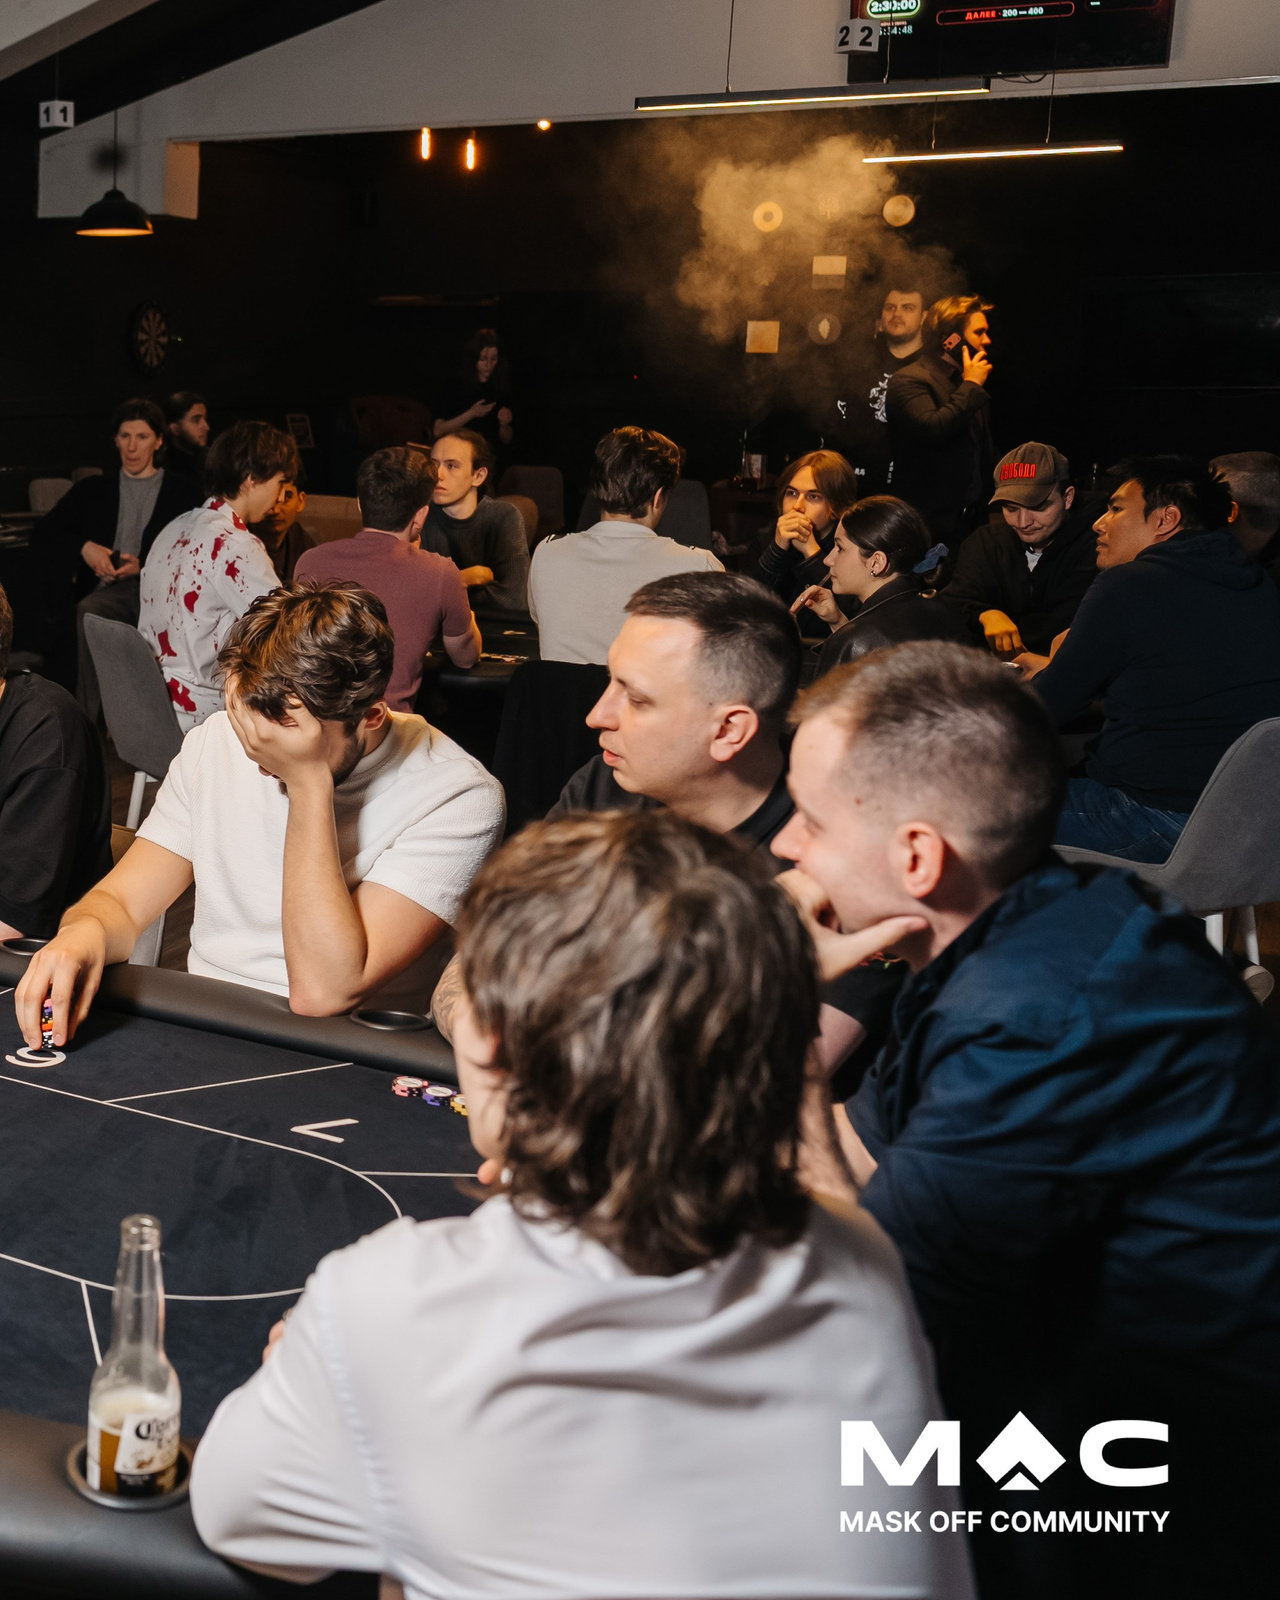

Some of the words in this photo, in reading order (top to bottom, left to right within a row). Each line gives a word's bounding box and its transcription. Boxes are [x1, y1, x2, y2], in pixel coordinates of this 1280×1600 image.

[965, 10, 996, 20] ДАЛЕЕ
[1002, 9, 1018, 17] 200
[1028, 7, 1044, 15] 400
[838, 25, 850, 47] 2
[859, 26, 873, 47] 2
[42, 106, 50, 123] 1
[59, 106, 68, 123] 1
[1000, 461, 1036, 481] СВОБОДА
[290, 1118, 359, 1143] 7
